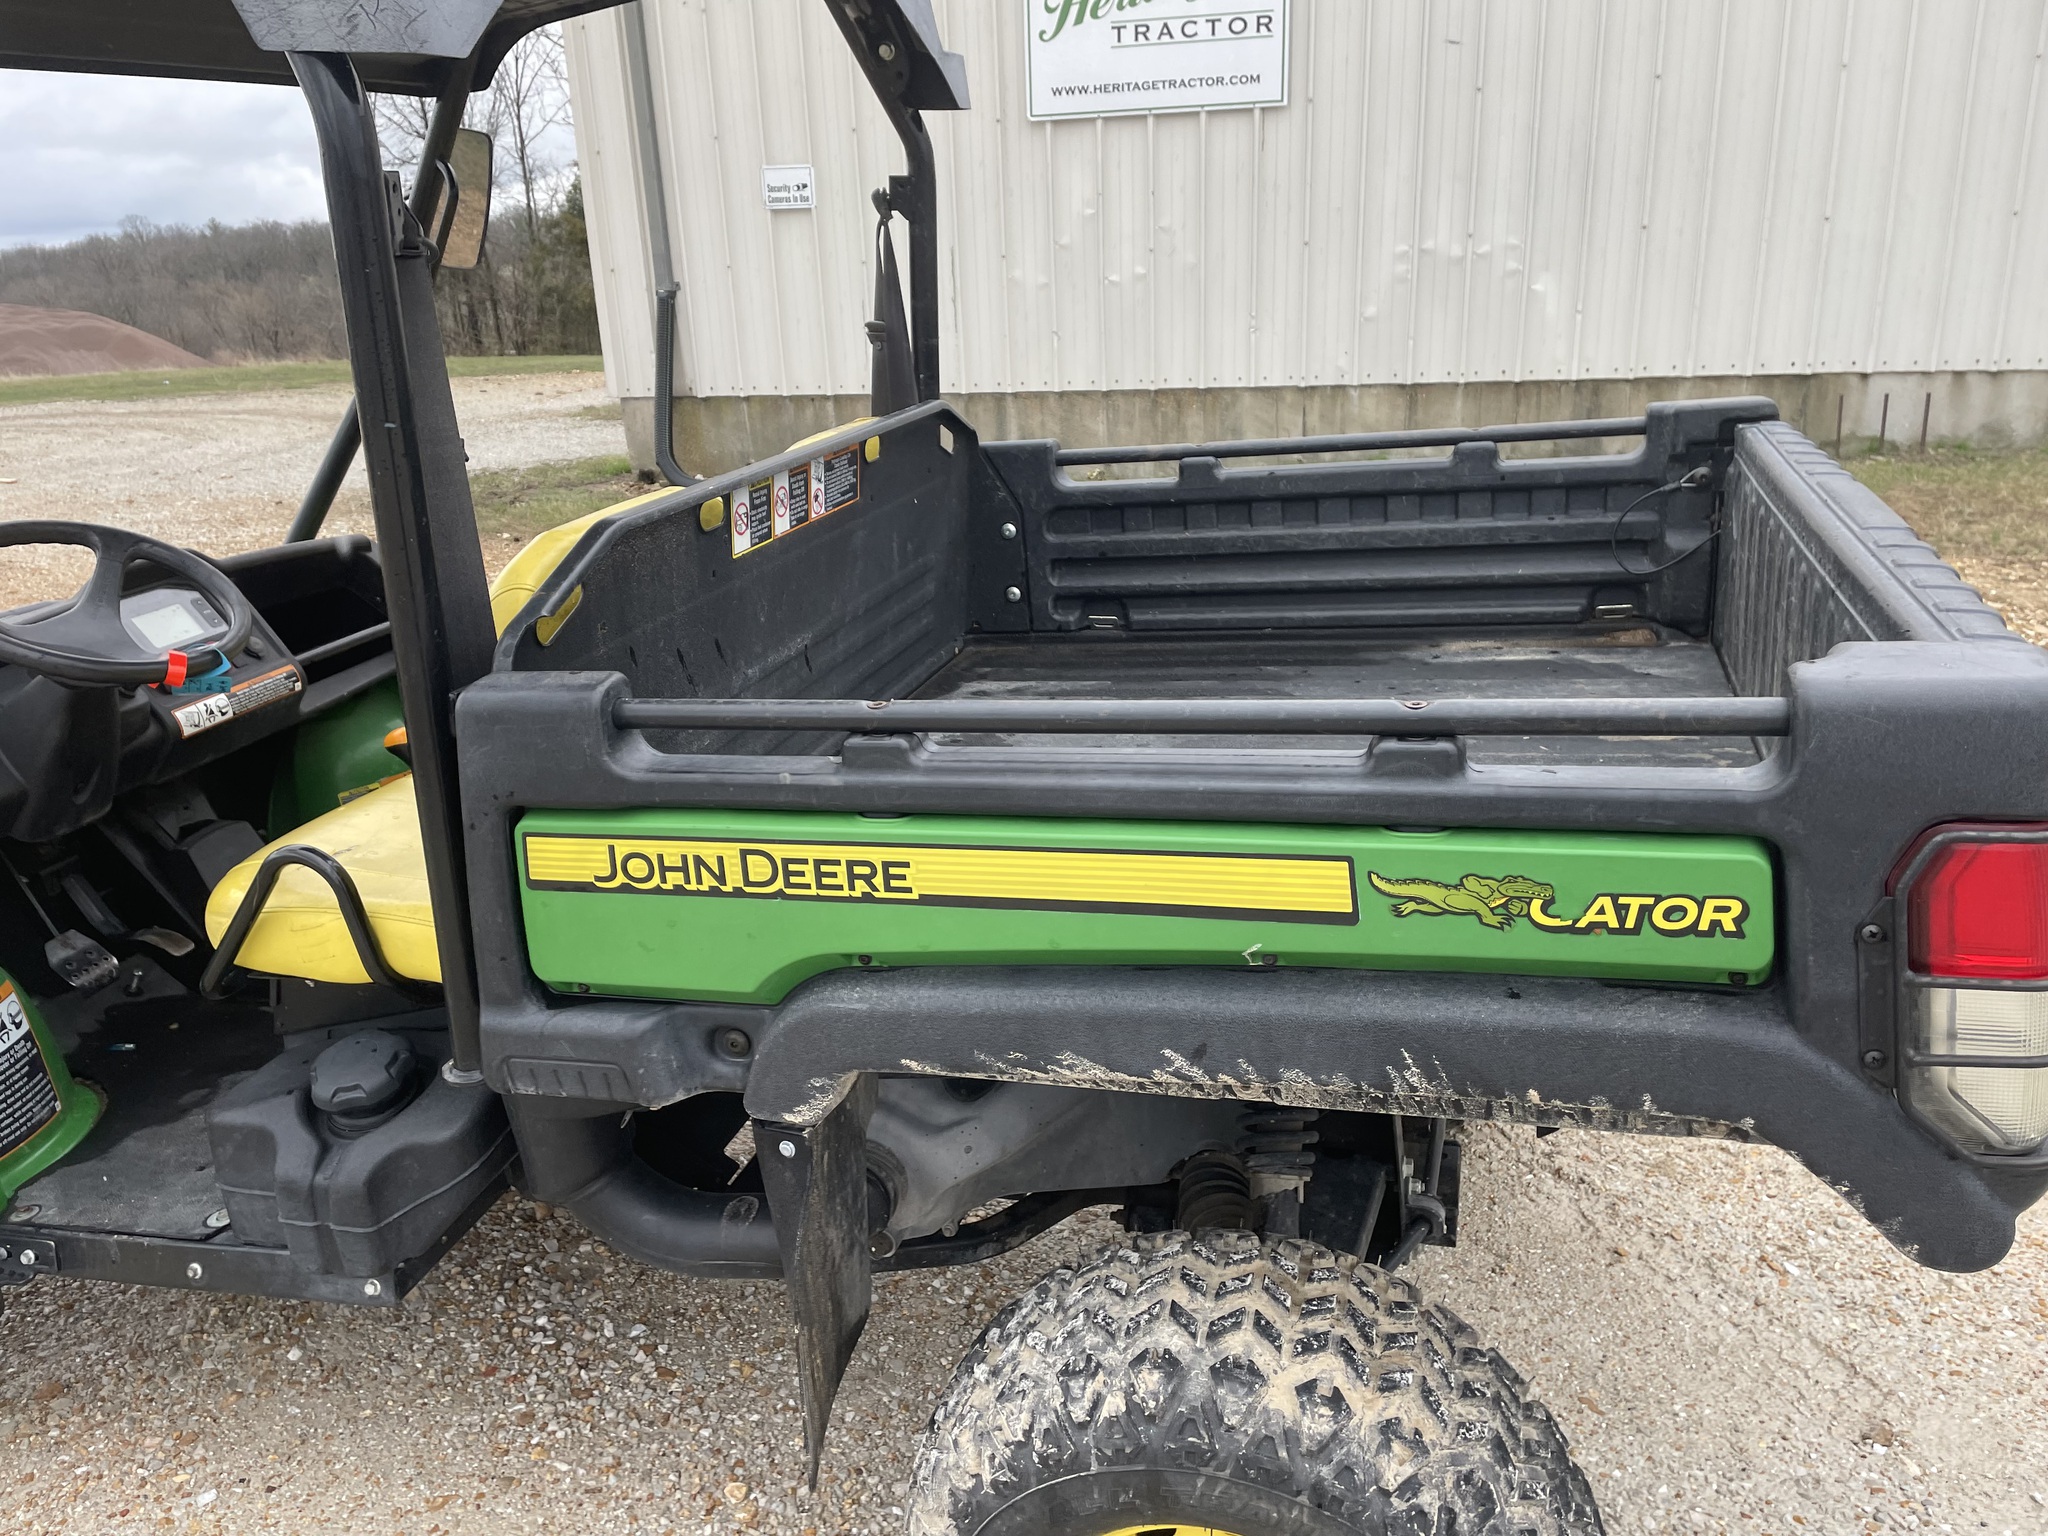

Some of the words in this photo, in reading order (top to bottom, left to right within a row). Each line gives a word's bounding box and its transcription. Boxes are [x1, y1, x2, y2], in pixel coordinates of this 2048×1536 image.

[1111, 15, 1273, 43] TRACTOR
[1051, 74, 1261, 97] WWW.HERITAGETRACTOR.COM
[767, 183, 791, 194] Security
[768, 194, 792, 203] Cameras
[799, 193, 809, 203] Use
[593, 844, 728, 888] JOHN
[739, 848, 914, 894] DEERE
[1528, 893, 1748, 938] GATOR
